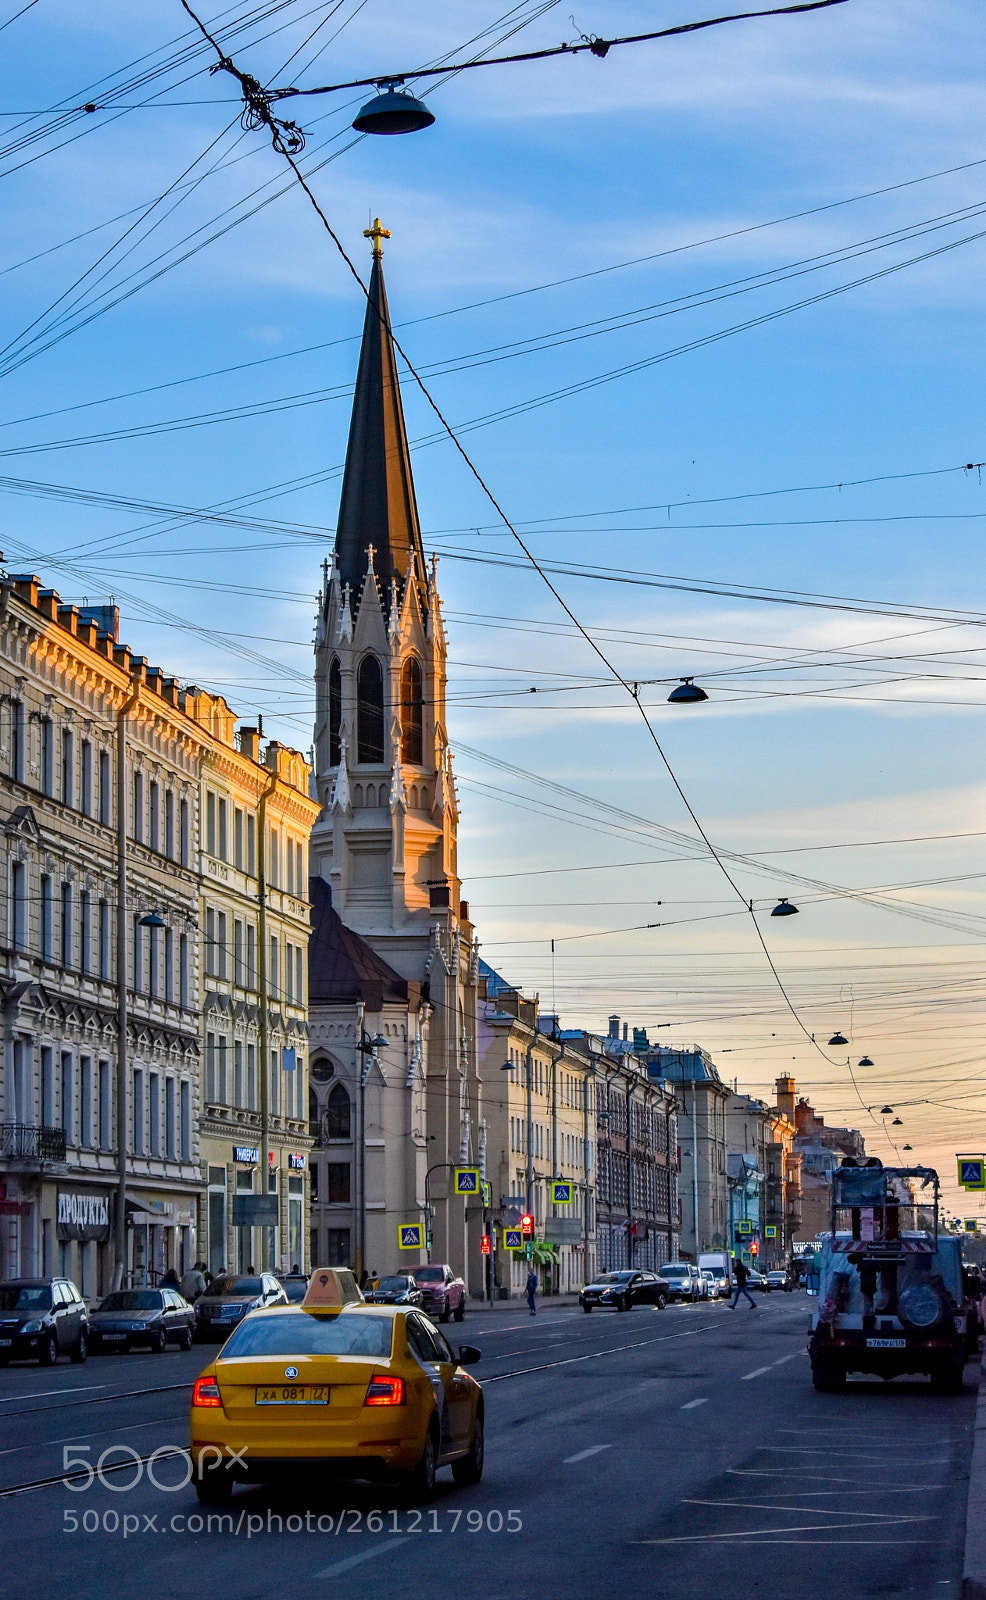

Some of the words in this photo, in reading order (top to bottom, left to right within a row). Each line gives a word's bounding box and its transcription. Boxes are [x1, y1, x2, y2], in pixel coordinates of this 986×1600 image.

[57, 1193, 109, 1231] ПРОДУКТЫ
[282, 1388, 305, 1400] 081
[312, 1387, 325, 1397] 77
